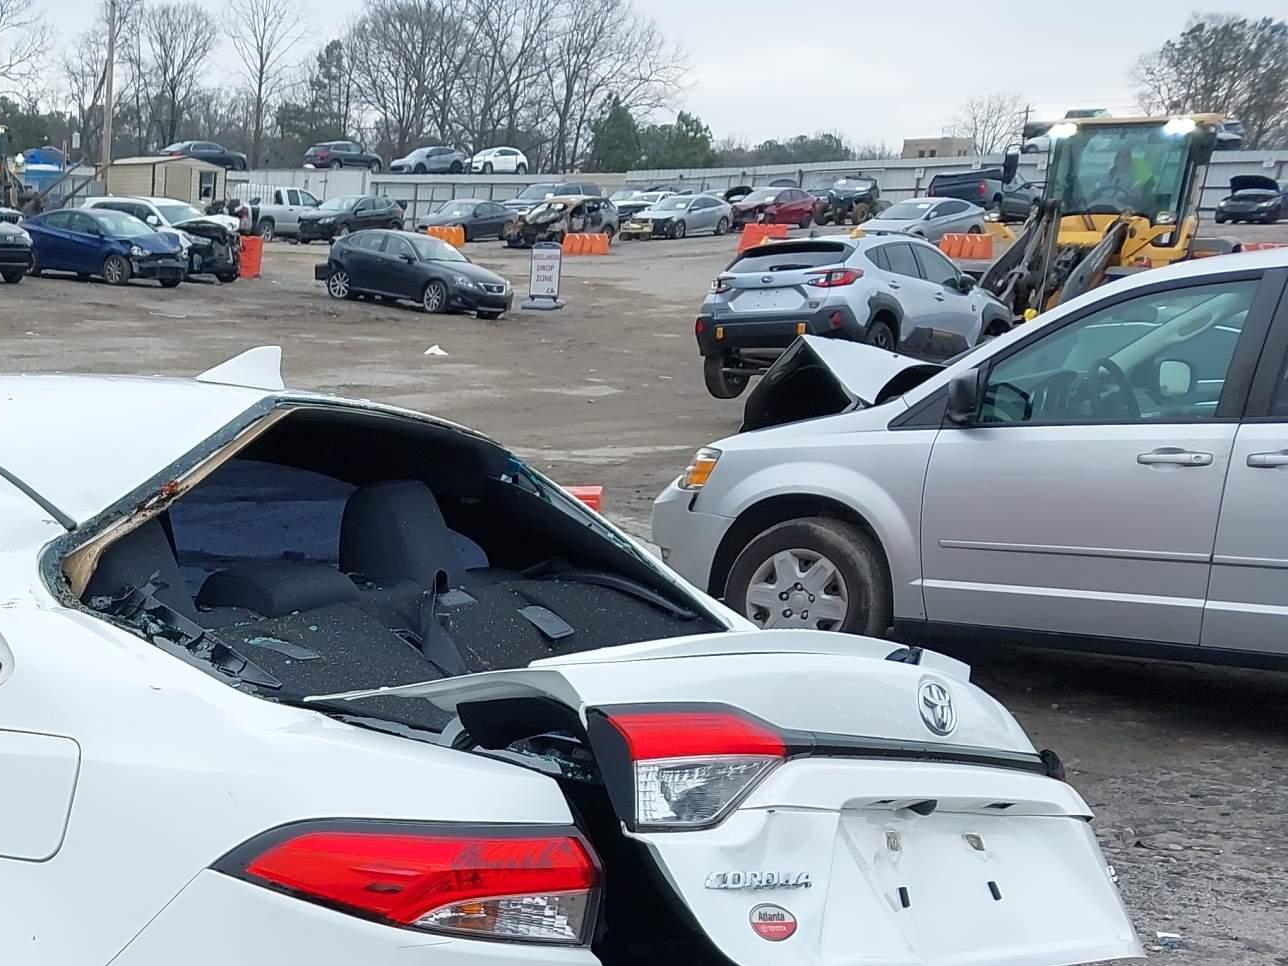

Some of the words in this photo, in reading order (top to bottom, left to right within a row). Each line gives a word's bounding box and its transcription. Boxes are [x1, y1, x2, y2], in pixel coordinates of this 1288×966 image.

[536, 264, 555, 272] DROP
[536, 274, 553, 282] ZONE
[705, 871, 813, 890] COROLLA
[758, 911, 785, 921] Atlanta
